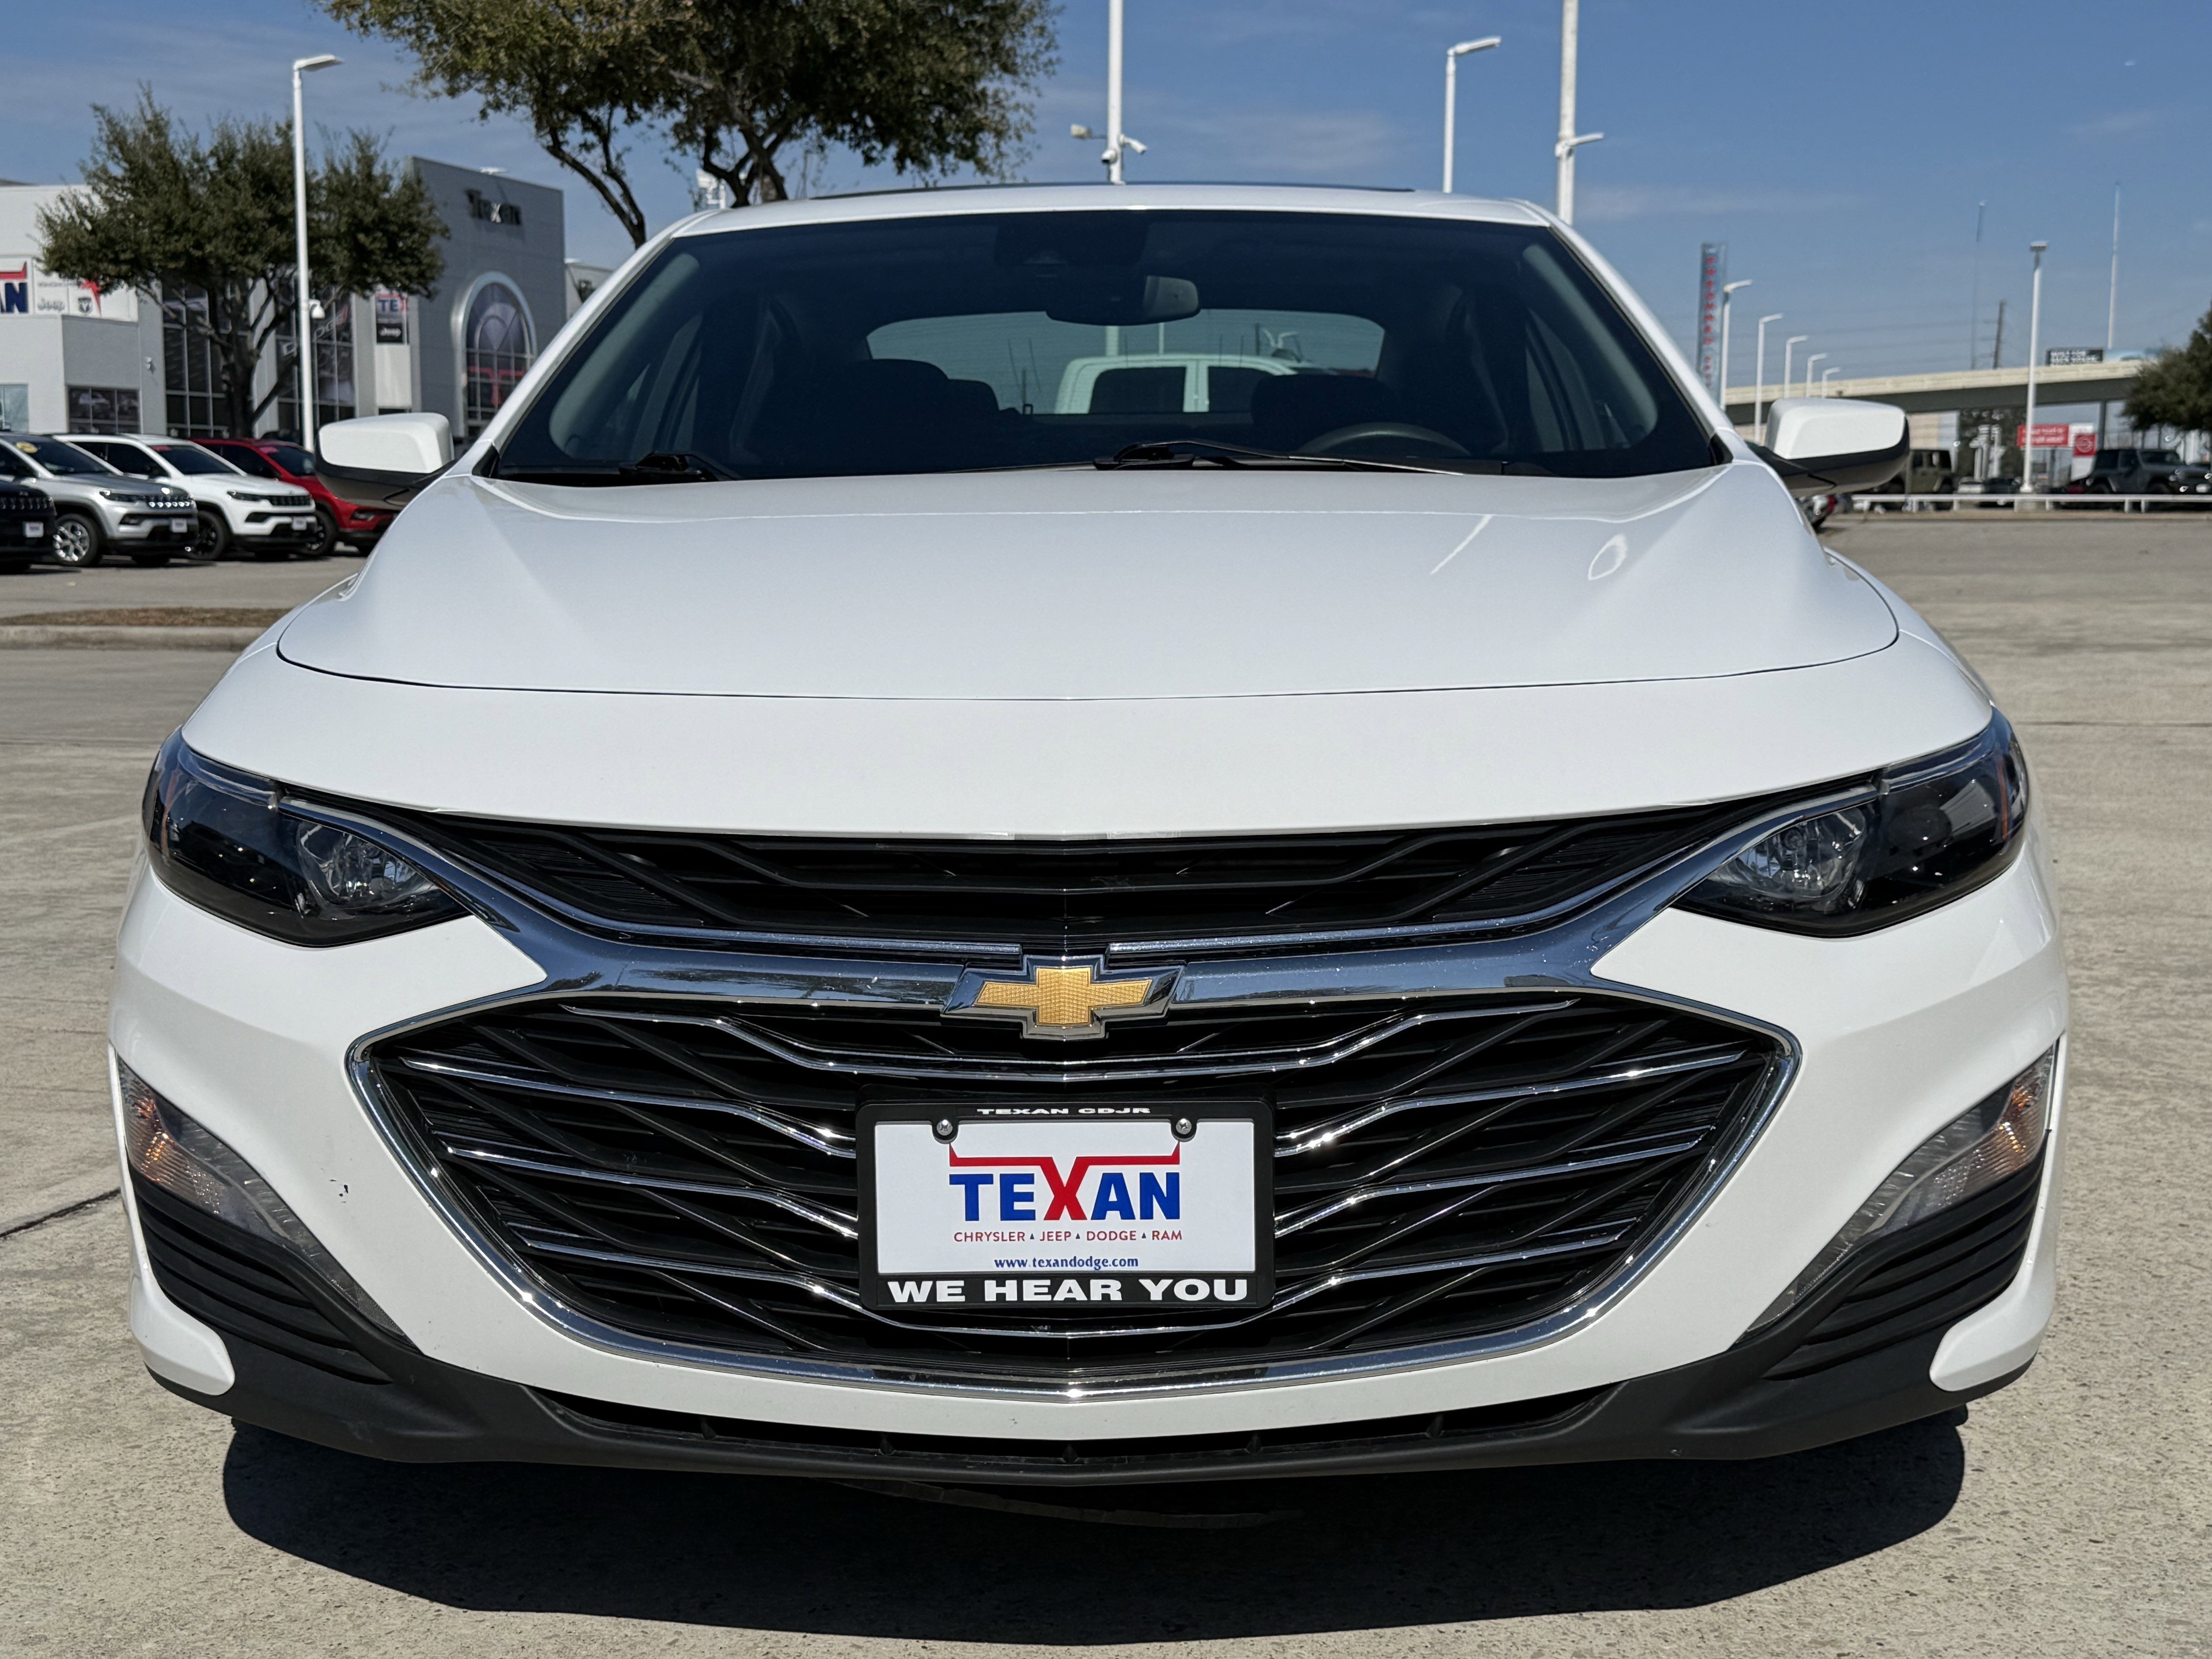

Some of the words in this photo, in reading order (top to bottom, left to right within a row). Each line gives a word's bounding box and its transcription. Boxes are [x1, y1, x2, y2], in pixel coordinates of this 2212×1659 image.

[0, 282, 27, 313] N
[950, 1154, 1180, 1221] TEXAN
[954, 1231, 1025, 1242] CHRYSLER
[1040, 1231, 1071, 1241] JEEP
[1087, 1231, 1136, 1241] DODGE
[1152, 1230, 1182, 1240] RAM
[994, 1255, 1139, 1271] www.texandodge.com
[888, 1280, 965, 1302] WE
[984, 1279, 1122, 1302] HEAR
[1139, 1279, 1247, 1301] YOU
